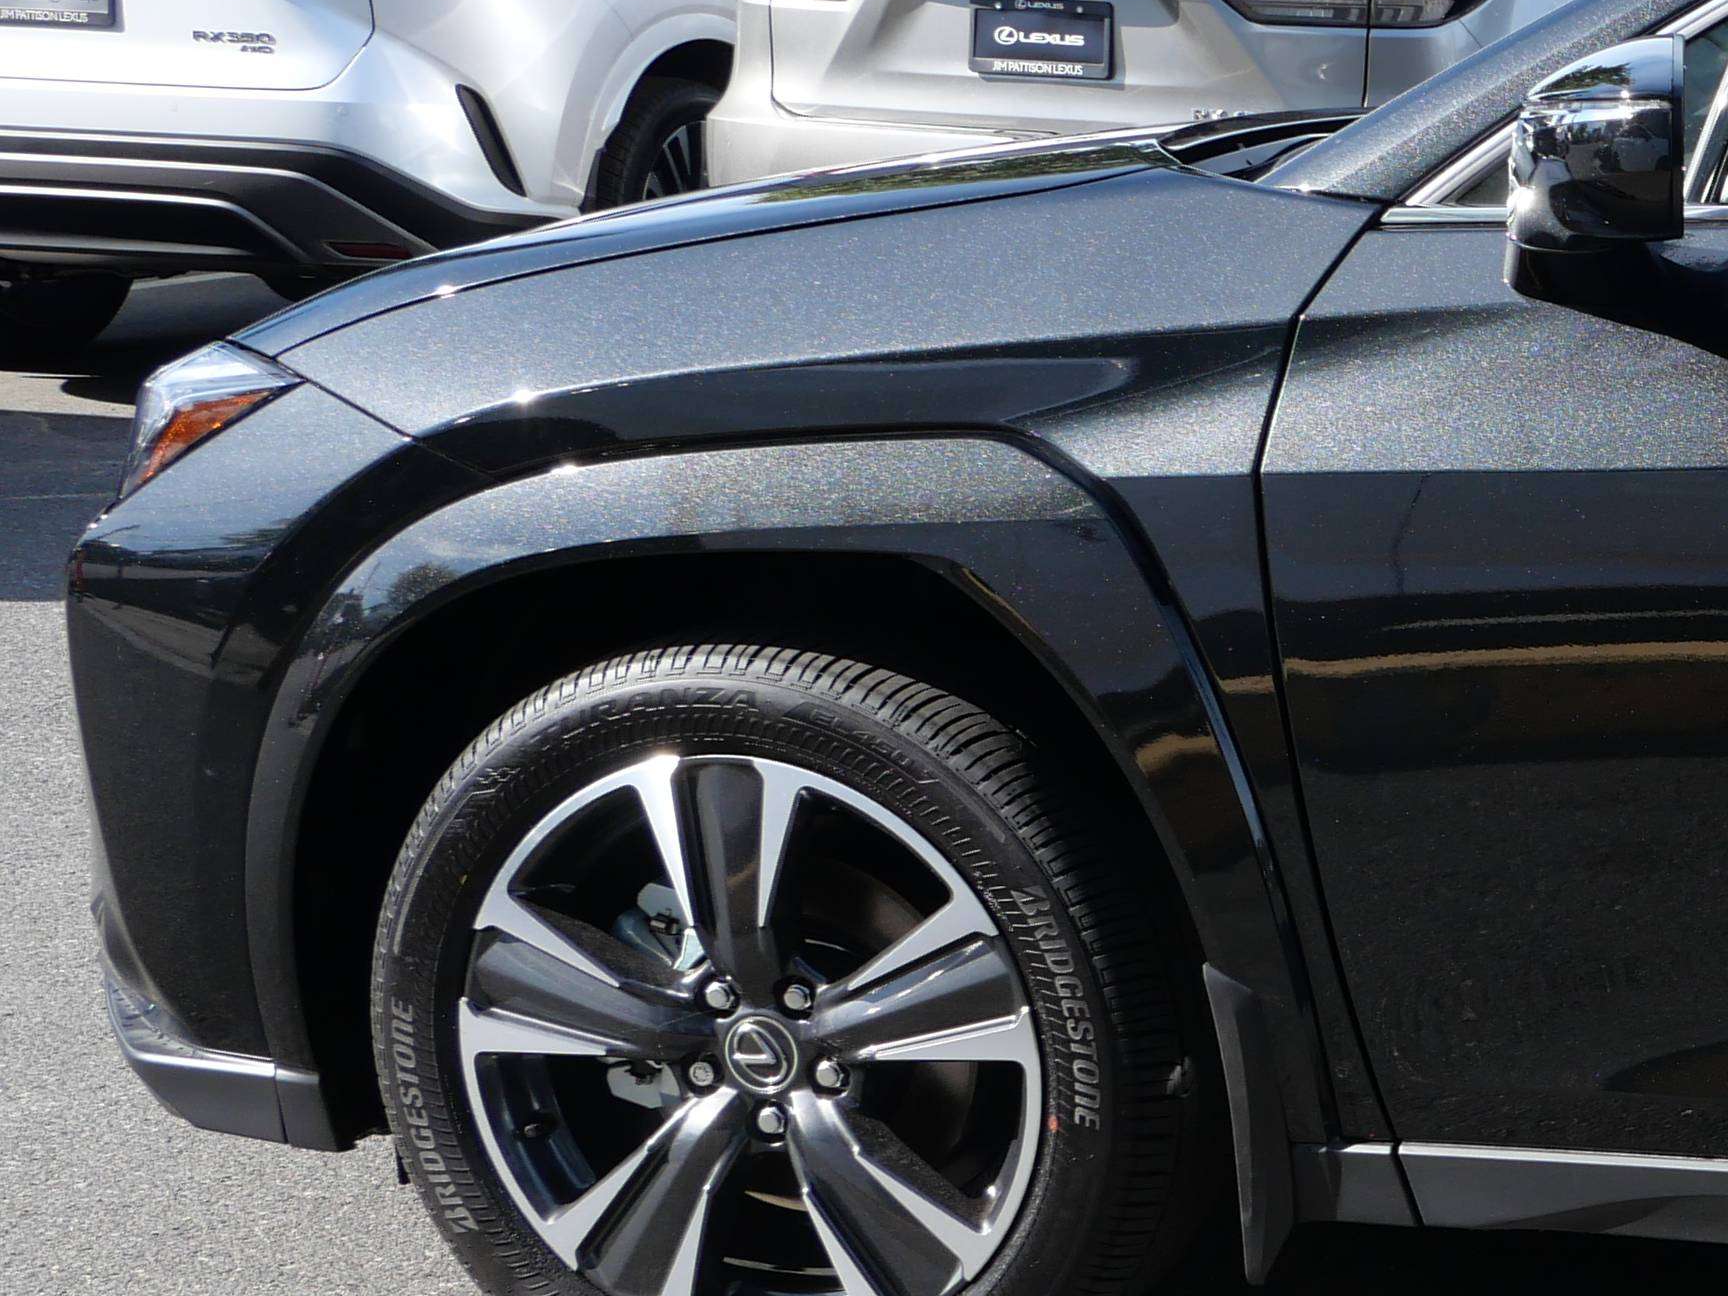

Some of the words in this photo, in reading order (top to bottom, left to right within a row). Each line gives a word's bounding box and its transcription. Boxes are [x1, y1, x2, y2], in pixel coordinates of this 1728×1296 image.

[1026, 1, 1064, 10] LEXUS
[15, 9, 58, 21] PATTISON
[59, 11, 88, 23] LEXUS
[1018, 31, 1085, 47] LEXUS
[992, 61, 1008, 72] JIM
[1008, 61, 1052, 74] PATTISON
[1053, 64, 1083, 76] LEXUS
[1010, 885, 1101, 1131] BRIDGESTONE
[390, 996, 480, 1234] BRIDGESTONE
